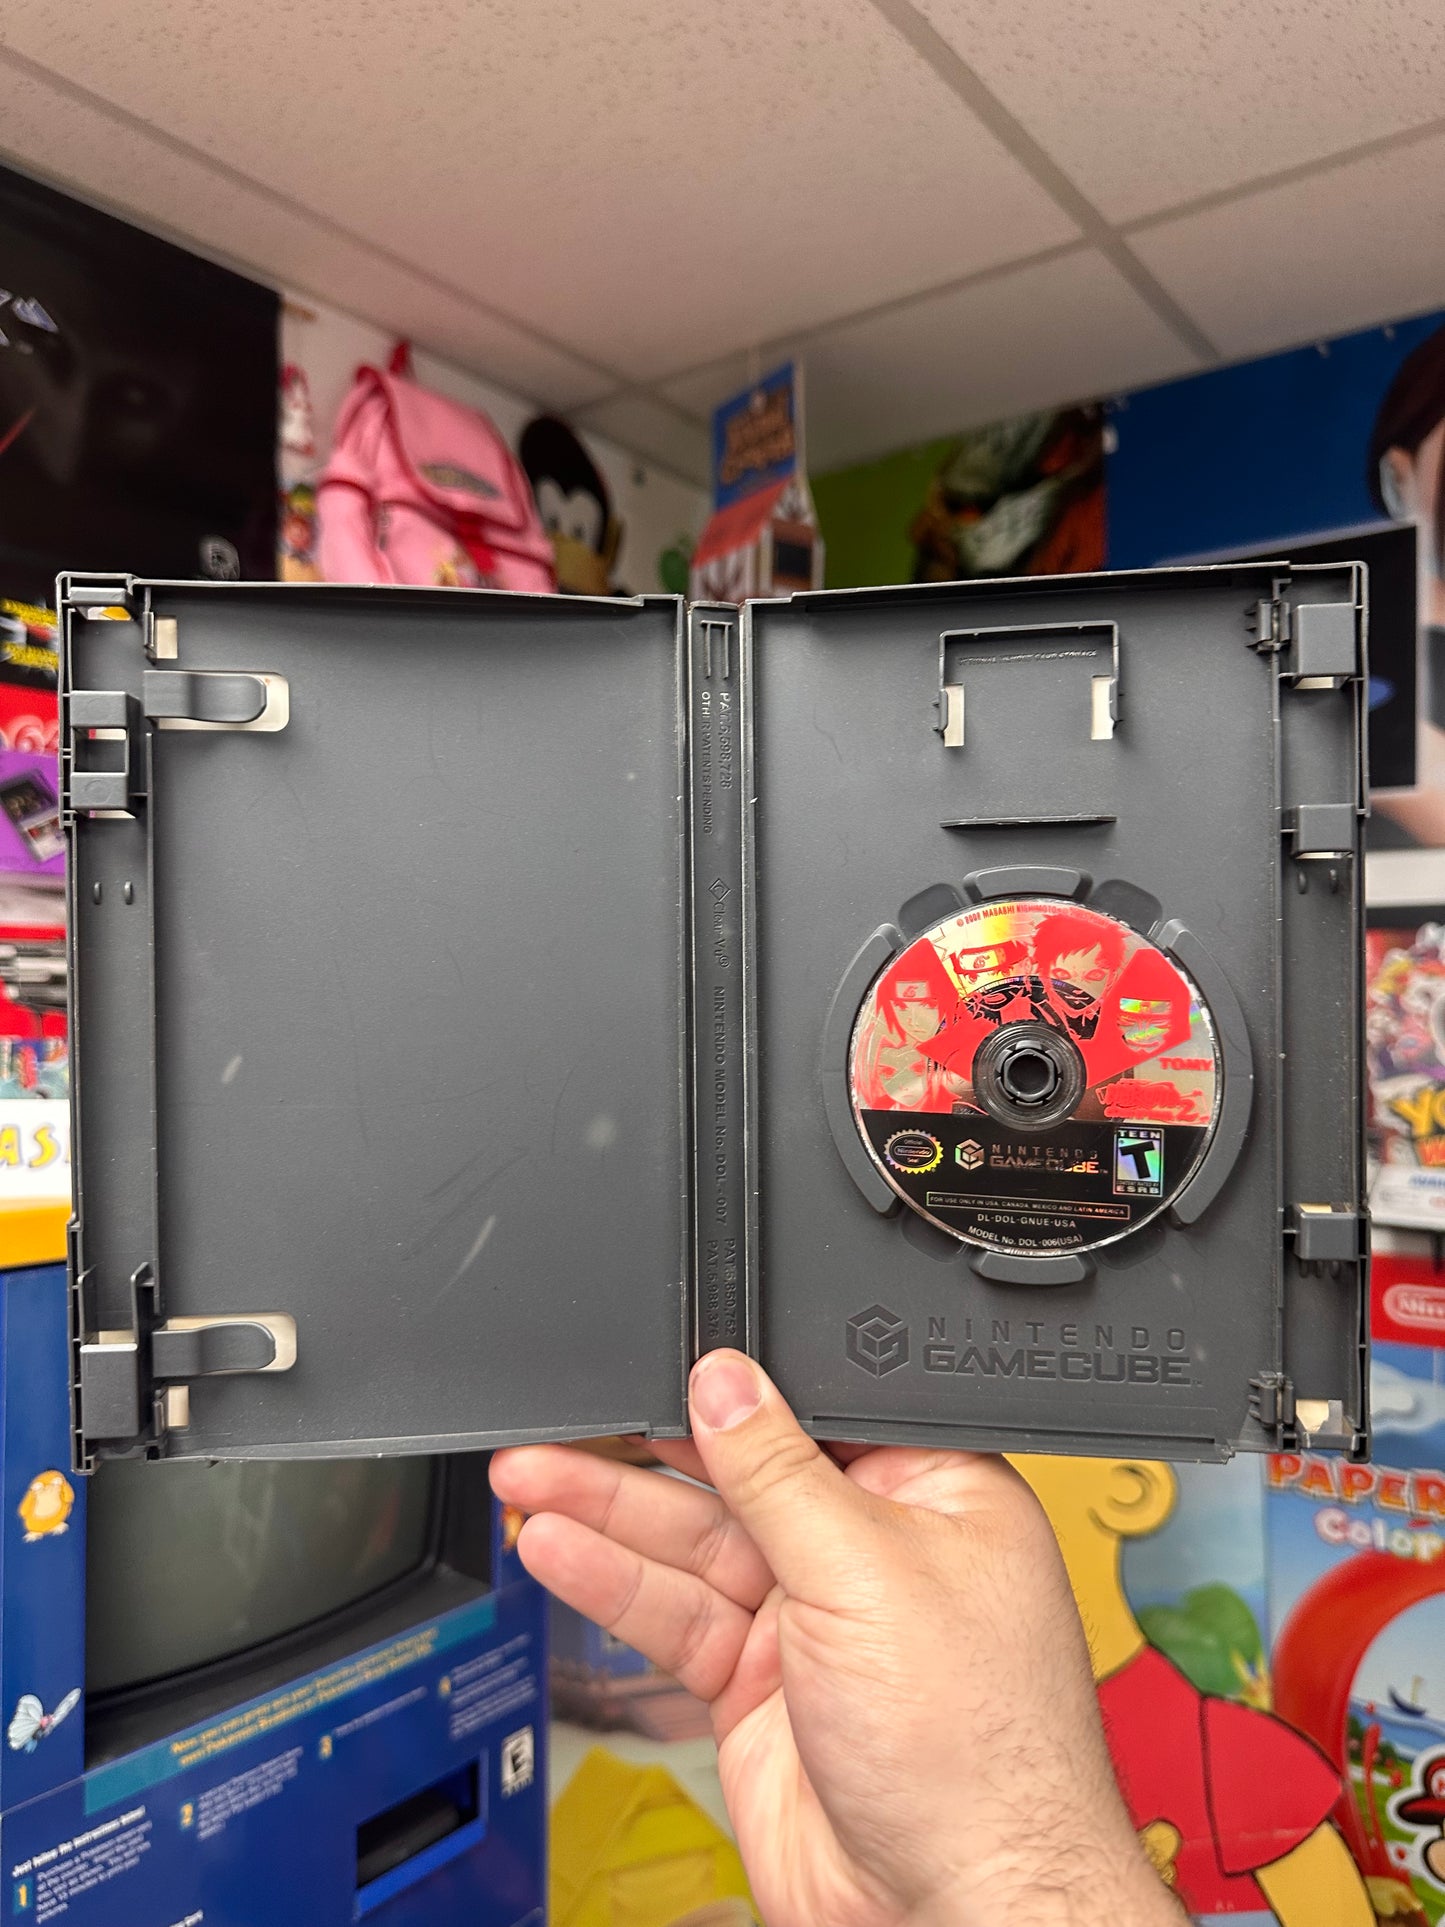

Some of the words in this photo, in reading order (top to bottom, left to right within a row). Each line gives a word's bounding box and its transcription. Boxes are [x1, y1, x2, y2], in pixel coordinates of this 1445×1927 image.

[713, 986, 726, 1066] NINTENDO
[714, 1070, 727, 1121] MODEL
[991, 1144, 1099, 1160] NINTENDO
[1118, 1130, 1161, 1139] TEEN
[1119, 1141, 1156, 1180] T
[1116, 1185, 1160, 1195] ESRB
[968, 1225, 999, 1243] MODEL
[1001, 1236, 1017, 1246] No.
[977, 1213, 1077, 1229] DL-DOL-GNUE-USA
[928, 1316, 1187, 1352] NINTENDO
[922, 1343, 1193, 1386] GAMECUBE
[1265, 1450, 1445, 1519] PAPER
[1314, 1506, 1445, 1562] Color
